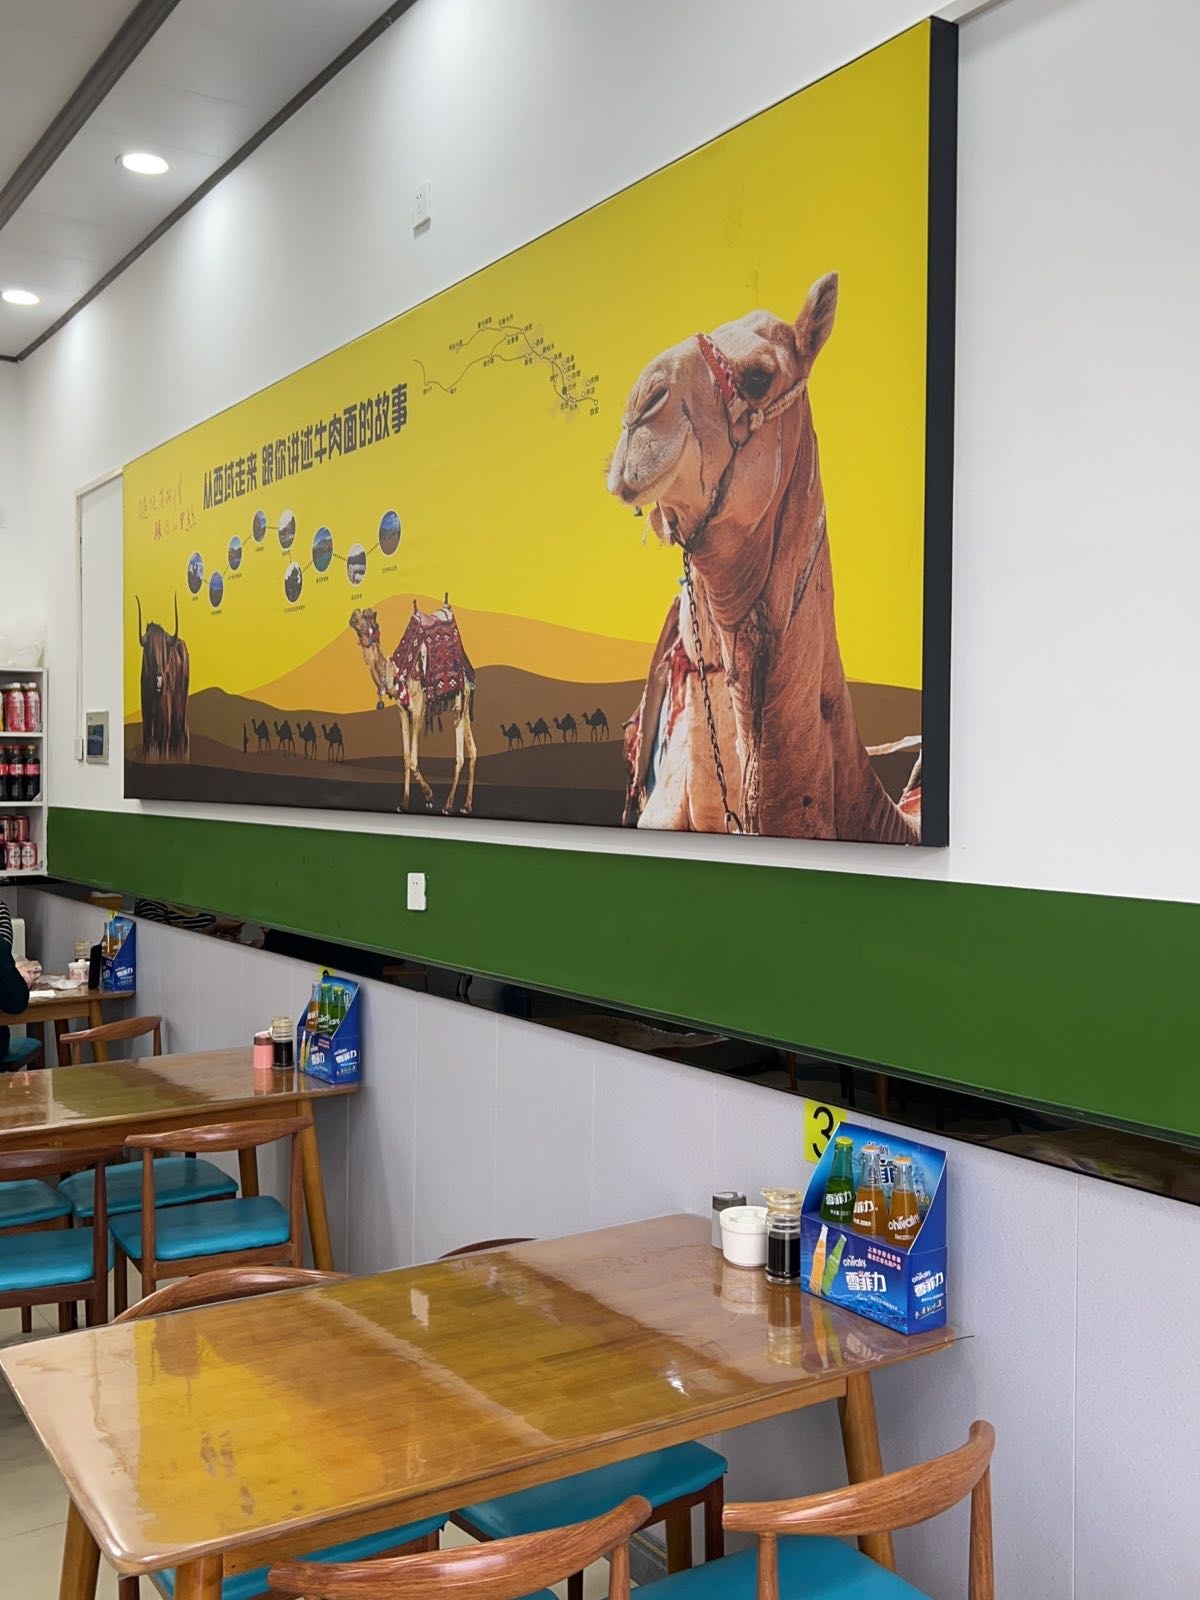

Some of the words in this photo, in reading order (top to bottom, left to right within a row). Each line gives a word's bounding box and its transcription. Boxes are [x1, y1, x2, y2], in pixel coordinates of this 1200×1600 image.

[203, 451, 258, 510] 从西域走来
[262, 383, 408, 487] 跟你讲述牛肉面的故事
[812, 1106, 834, 1159] 3
[853, 1199, 875, 1214] 菲力
[845, 1271, 887, 1293] 雪菲力
